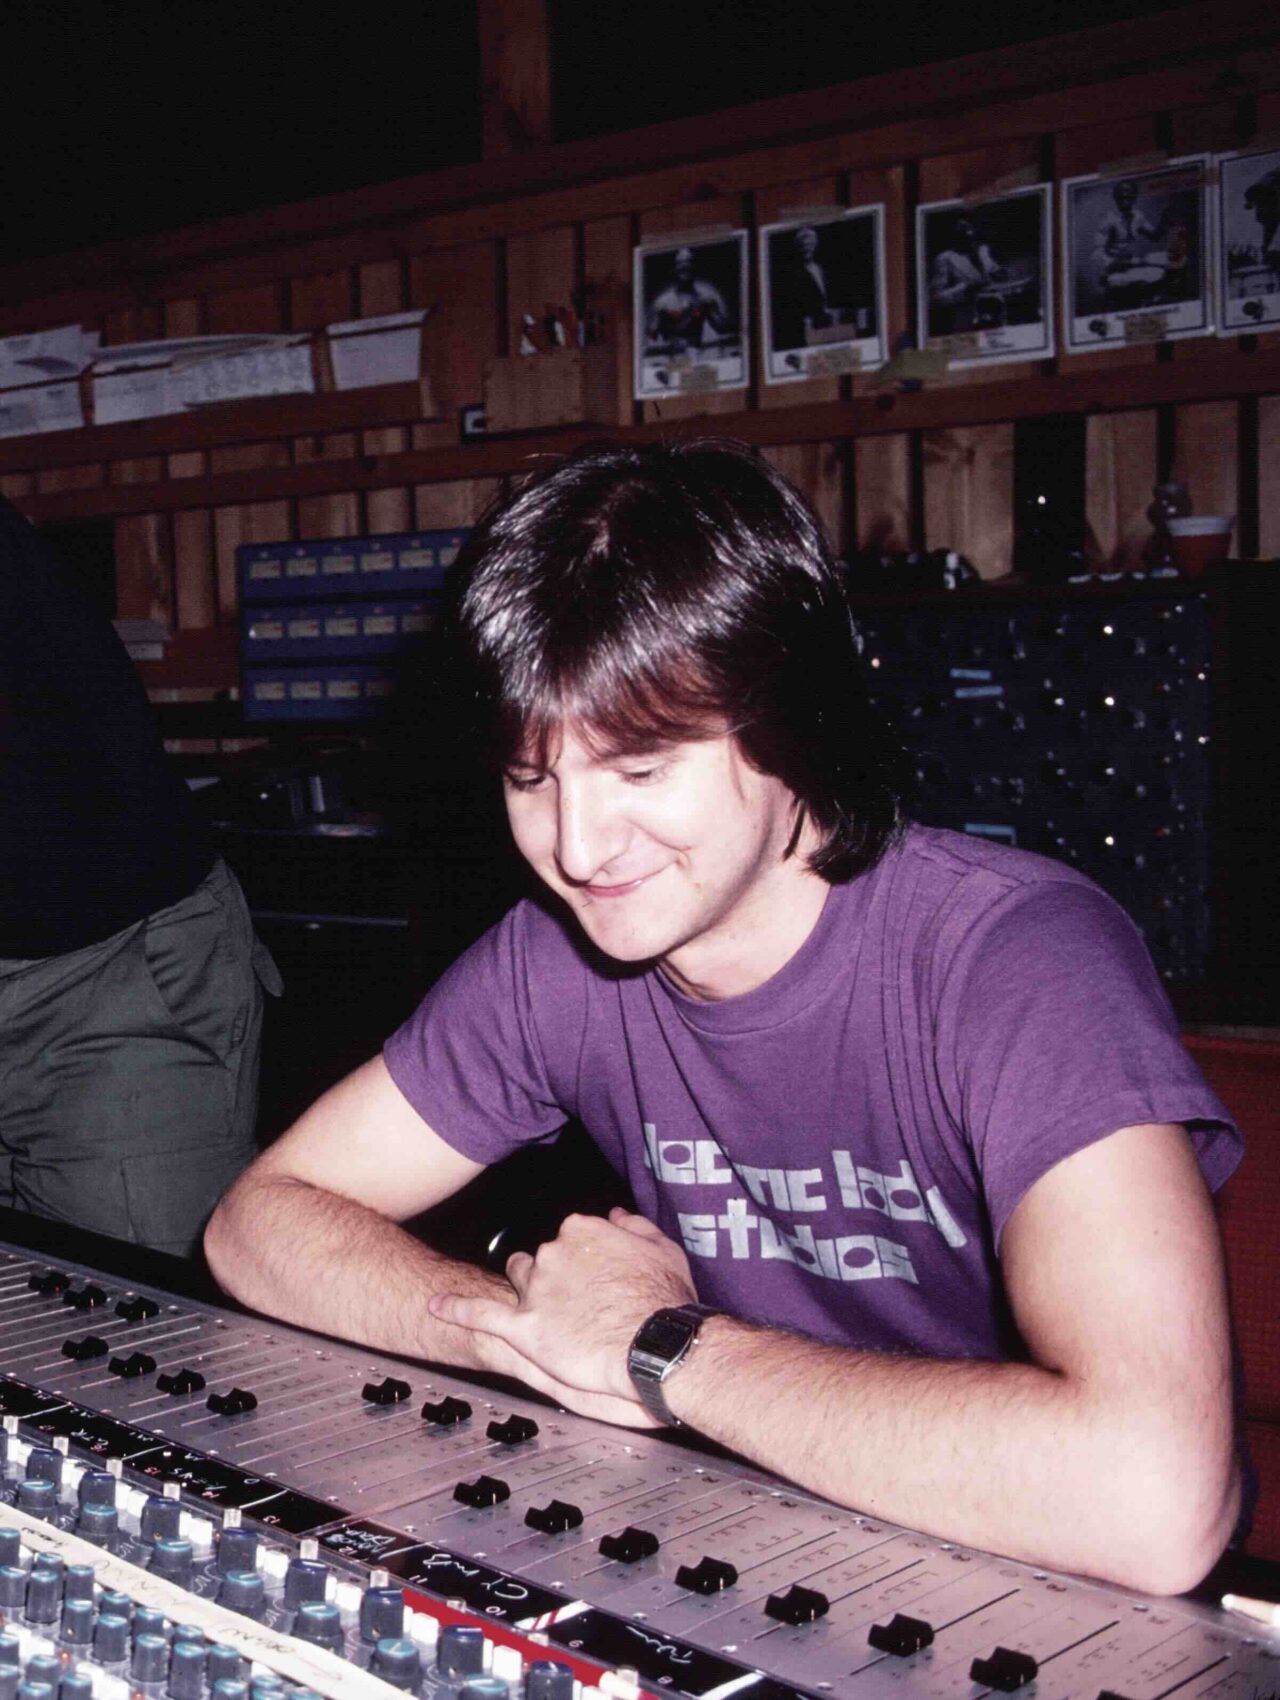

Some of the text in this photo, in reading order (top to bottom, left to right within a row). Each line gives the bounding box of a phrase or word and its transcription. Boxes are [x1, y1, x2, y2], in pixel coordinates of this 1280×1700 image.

[677, 1198, 919, 1285] studios
[262, 1514, 281, 1525] 13
[339, 1545, 358, 1556] 12
[484, 1605, 507, 1616] 10
